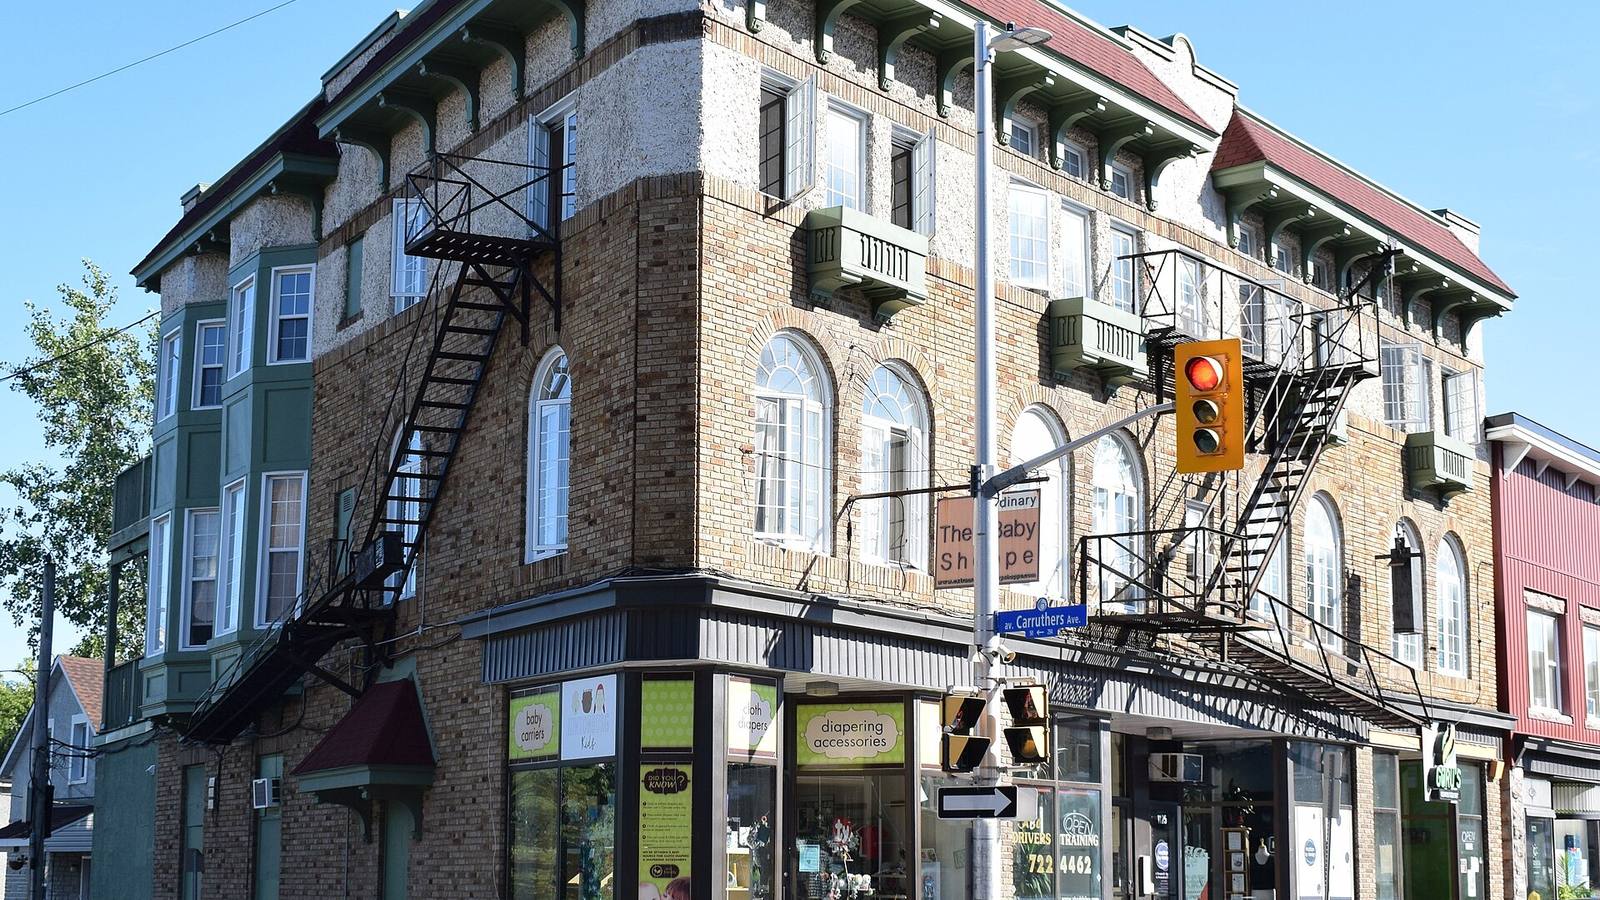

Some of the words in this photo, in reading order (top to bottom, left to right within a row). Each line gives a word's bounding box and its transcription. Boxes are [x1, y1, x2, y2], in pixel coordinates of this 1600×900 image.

[940, 525, 972, 543] The
[941, 549, 1034, 571] Shpe
[1016, 612, 1064, 629] Carruthers
[1067, 615, 1081, 625] Ave.
[743, 701, 762, 716] cloth
[526, 709, 543, 728] baby
[738, 716, 768, 733] diapers
[521, 728, 545, 742] carriers
[821, 719, 883, 736] diapering
[814, 735, 887, 748] accessories
[1012, 832, 1052, 845] DRIVERS
[1060, 834, 1099, 847] TRAINING
[1029, 854, 1053, 873] 722
[1060, 855, 1092, 874] 4462
